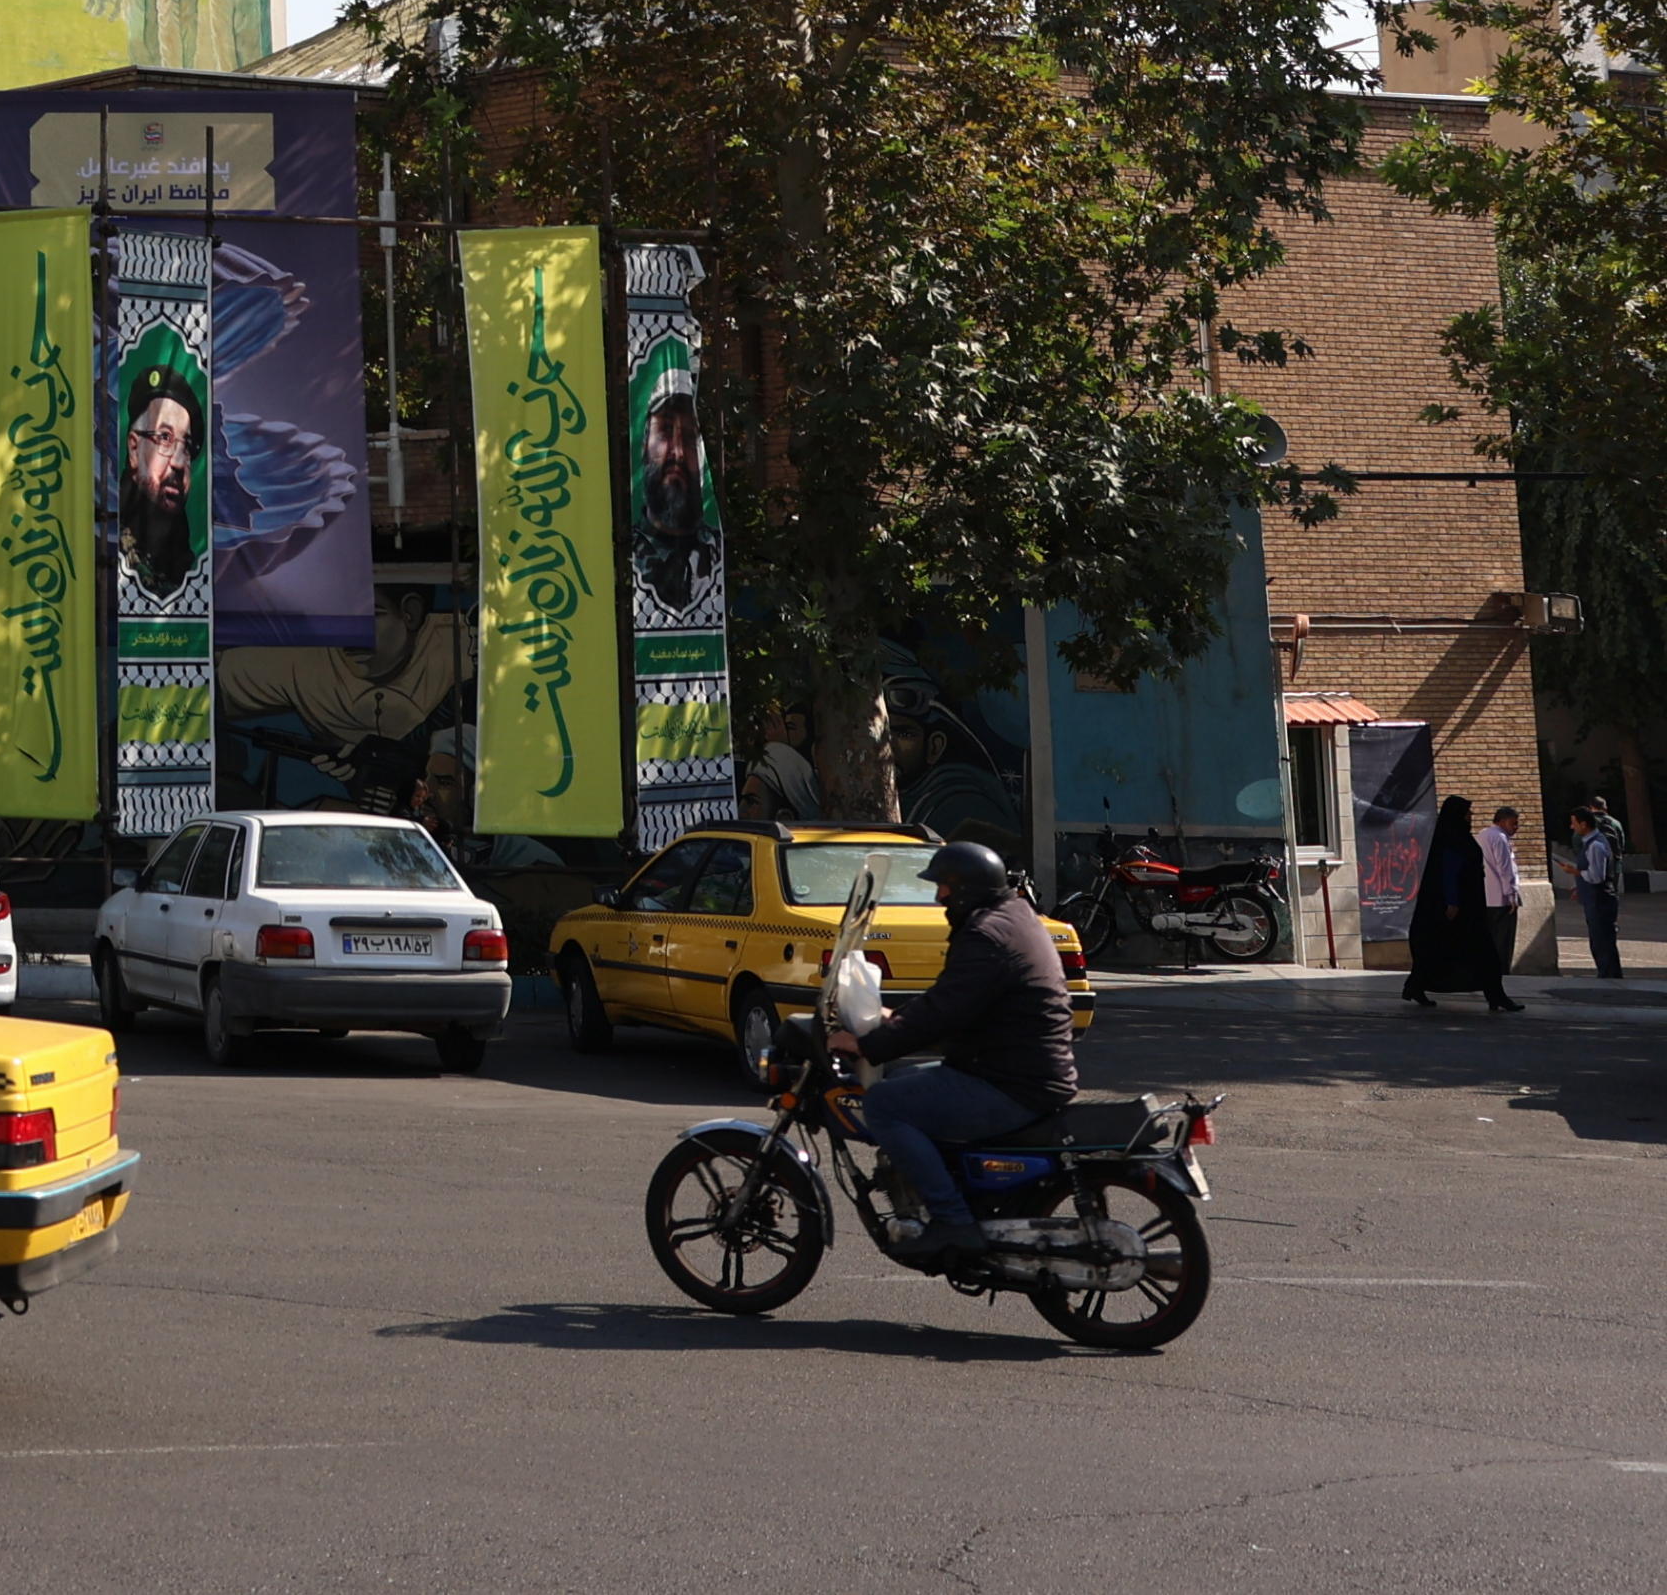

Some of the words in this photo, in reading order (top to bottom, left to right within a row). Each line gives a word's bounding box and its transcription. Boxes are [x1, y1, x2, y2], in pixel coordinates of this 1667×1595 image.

[122, 184, 162, 204] ایران
[3, 601, 64, 782] است
[498, 617, 574, 798] است
